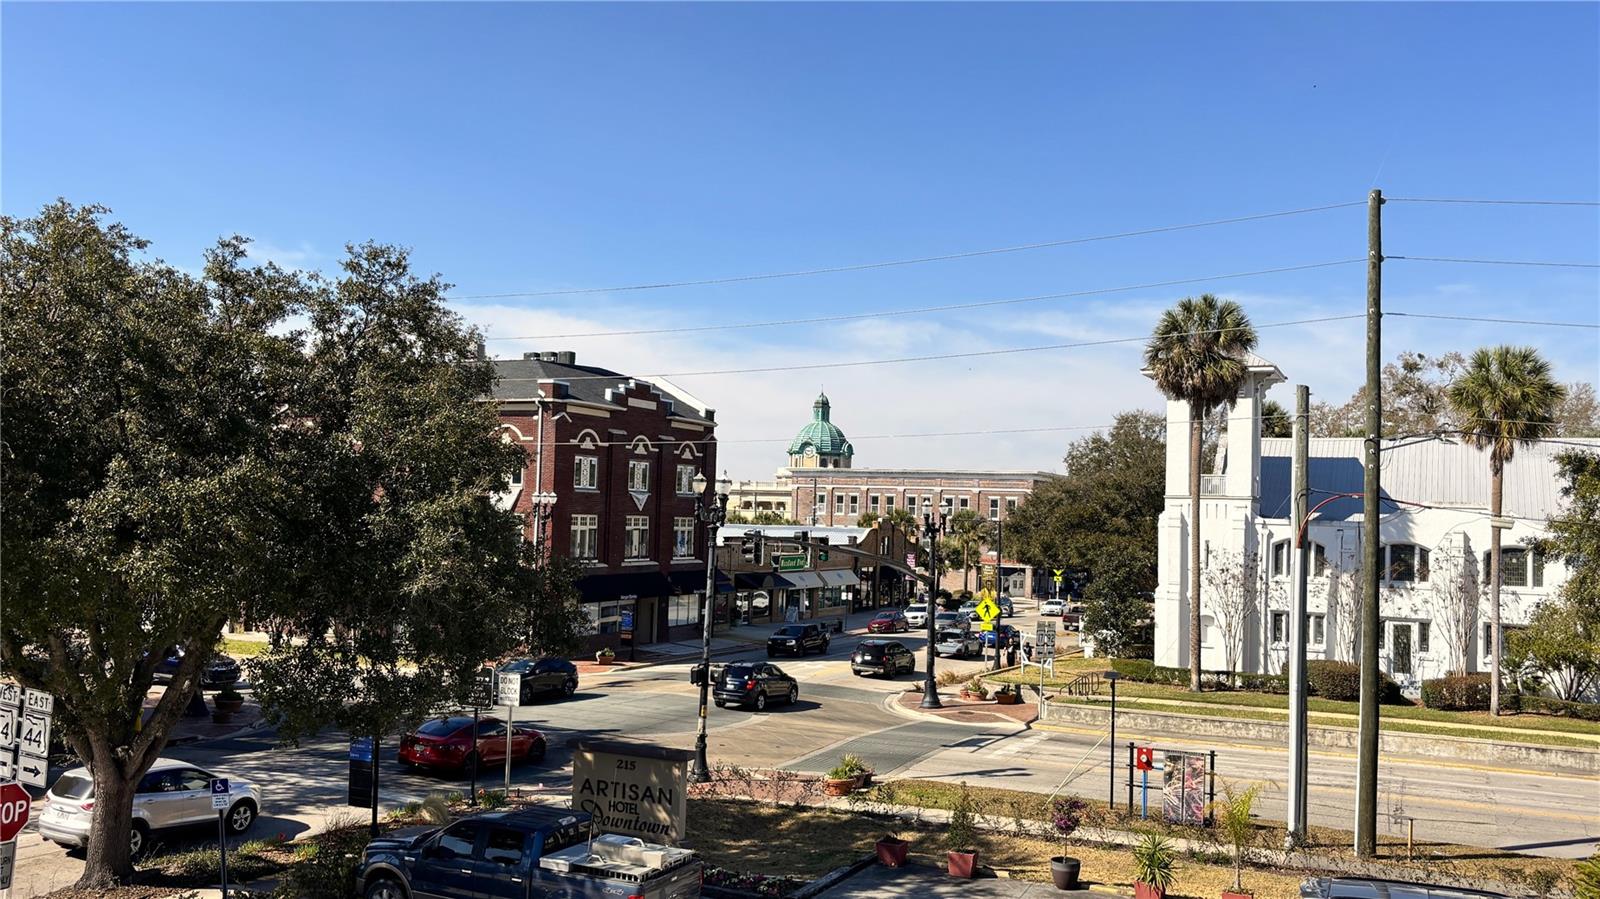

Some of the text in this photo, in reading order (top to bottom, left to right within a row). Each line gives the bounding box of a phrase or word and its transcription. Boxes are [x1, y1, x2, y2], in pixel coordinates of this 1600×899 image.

[500, 676, 519, 686] DO NOT
[500, 686, 518, 695] BLOCK
[28, 692, 49, 710] EAST
[0, 722, 9, 740] 4
[24, 727, 42, 748] 44
[616, 760, 636, 770] 215
[580, 778, 673, 806] ARTISAN
[0, 800, 27, 824] OP
[608, 801, 640, 815] HOTEL
[581, 799, 671, 836] Downtown
